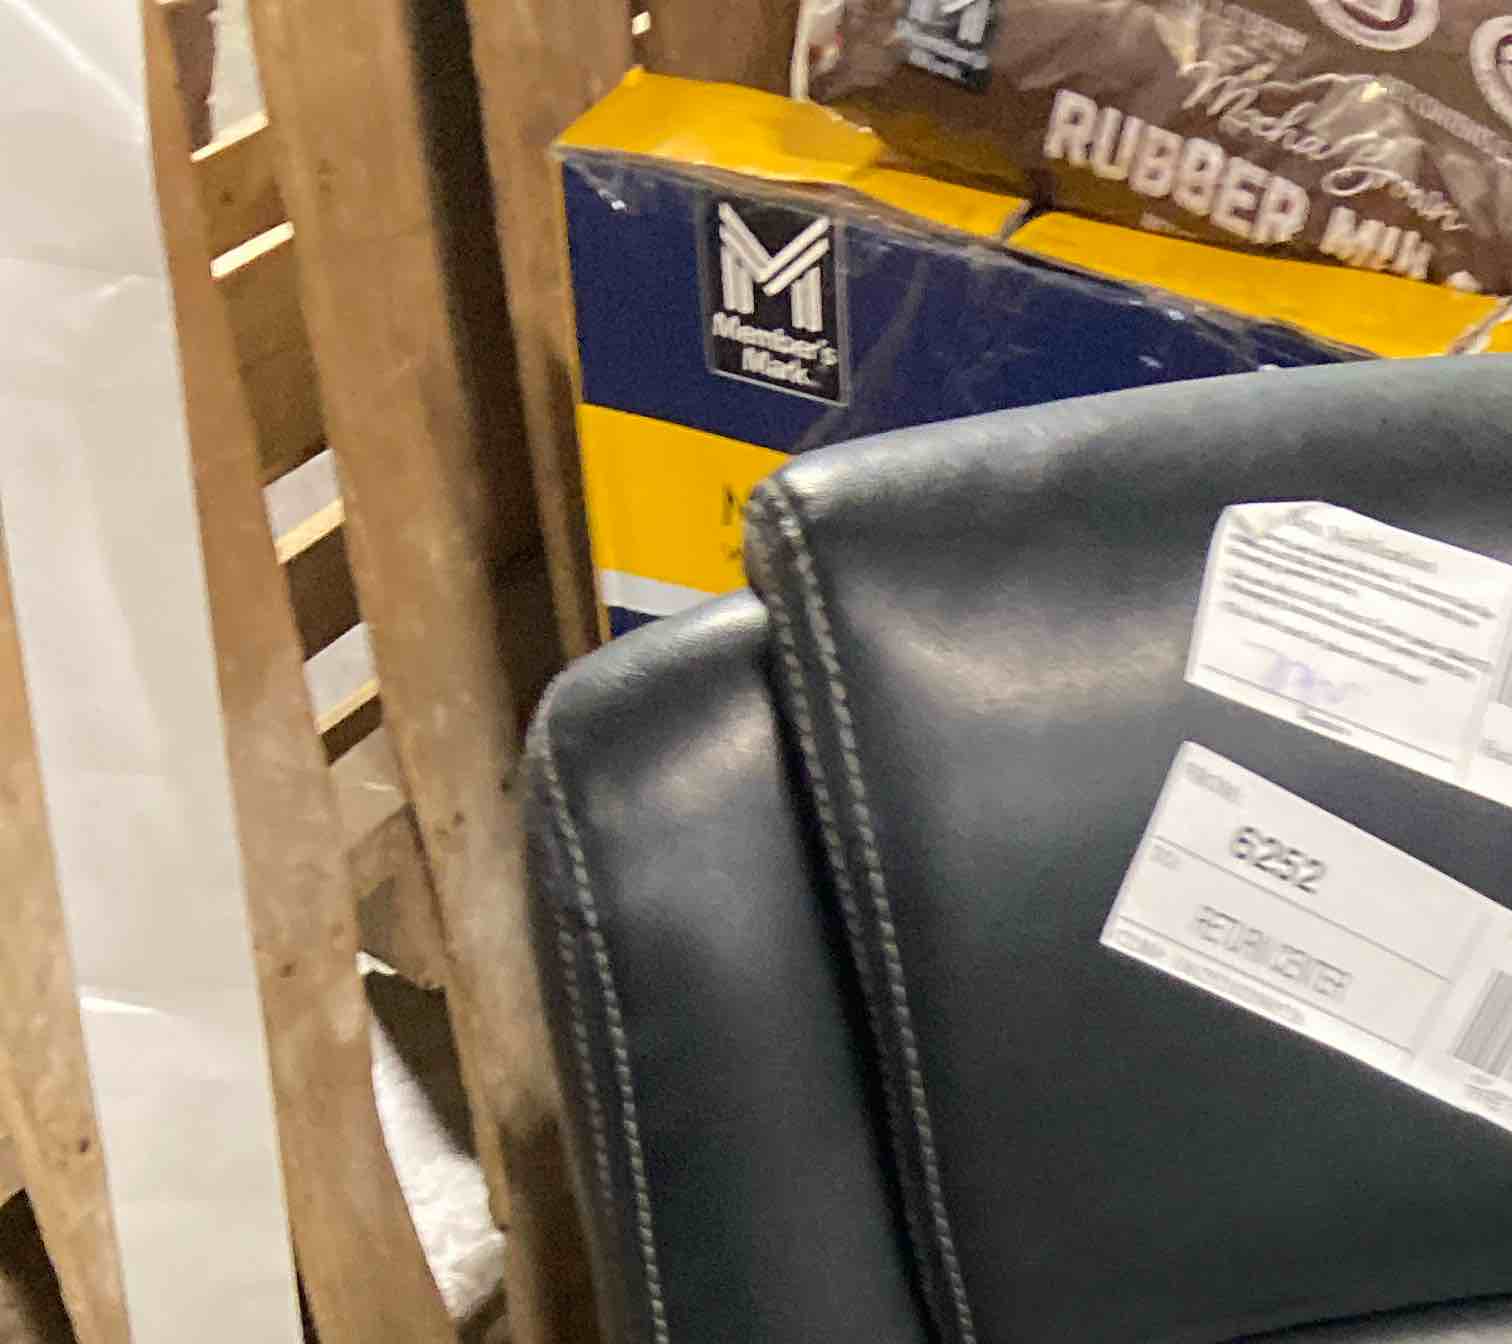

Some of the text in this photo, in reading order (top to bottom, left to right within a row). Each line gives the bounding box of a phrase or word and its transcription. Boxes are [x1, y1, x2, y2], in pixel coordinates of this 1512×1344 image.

[1043, 88, 1310, 244] RUBBER
[1320, 206, 1483, 291] MUL
[711, 312, 838, 366] Member's
[741, 348, 815, 386] Mark
[1230, 824, 1328, 895] 6252
